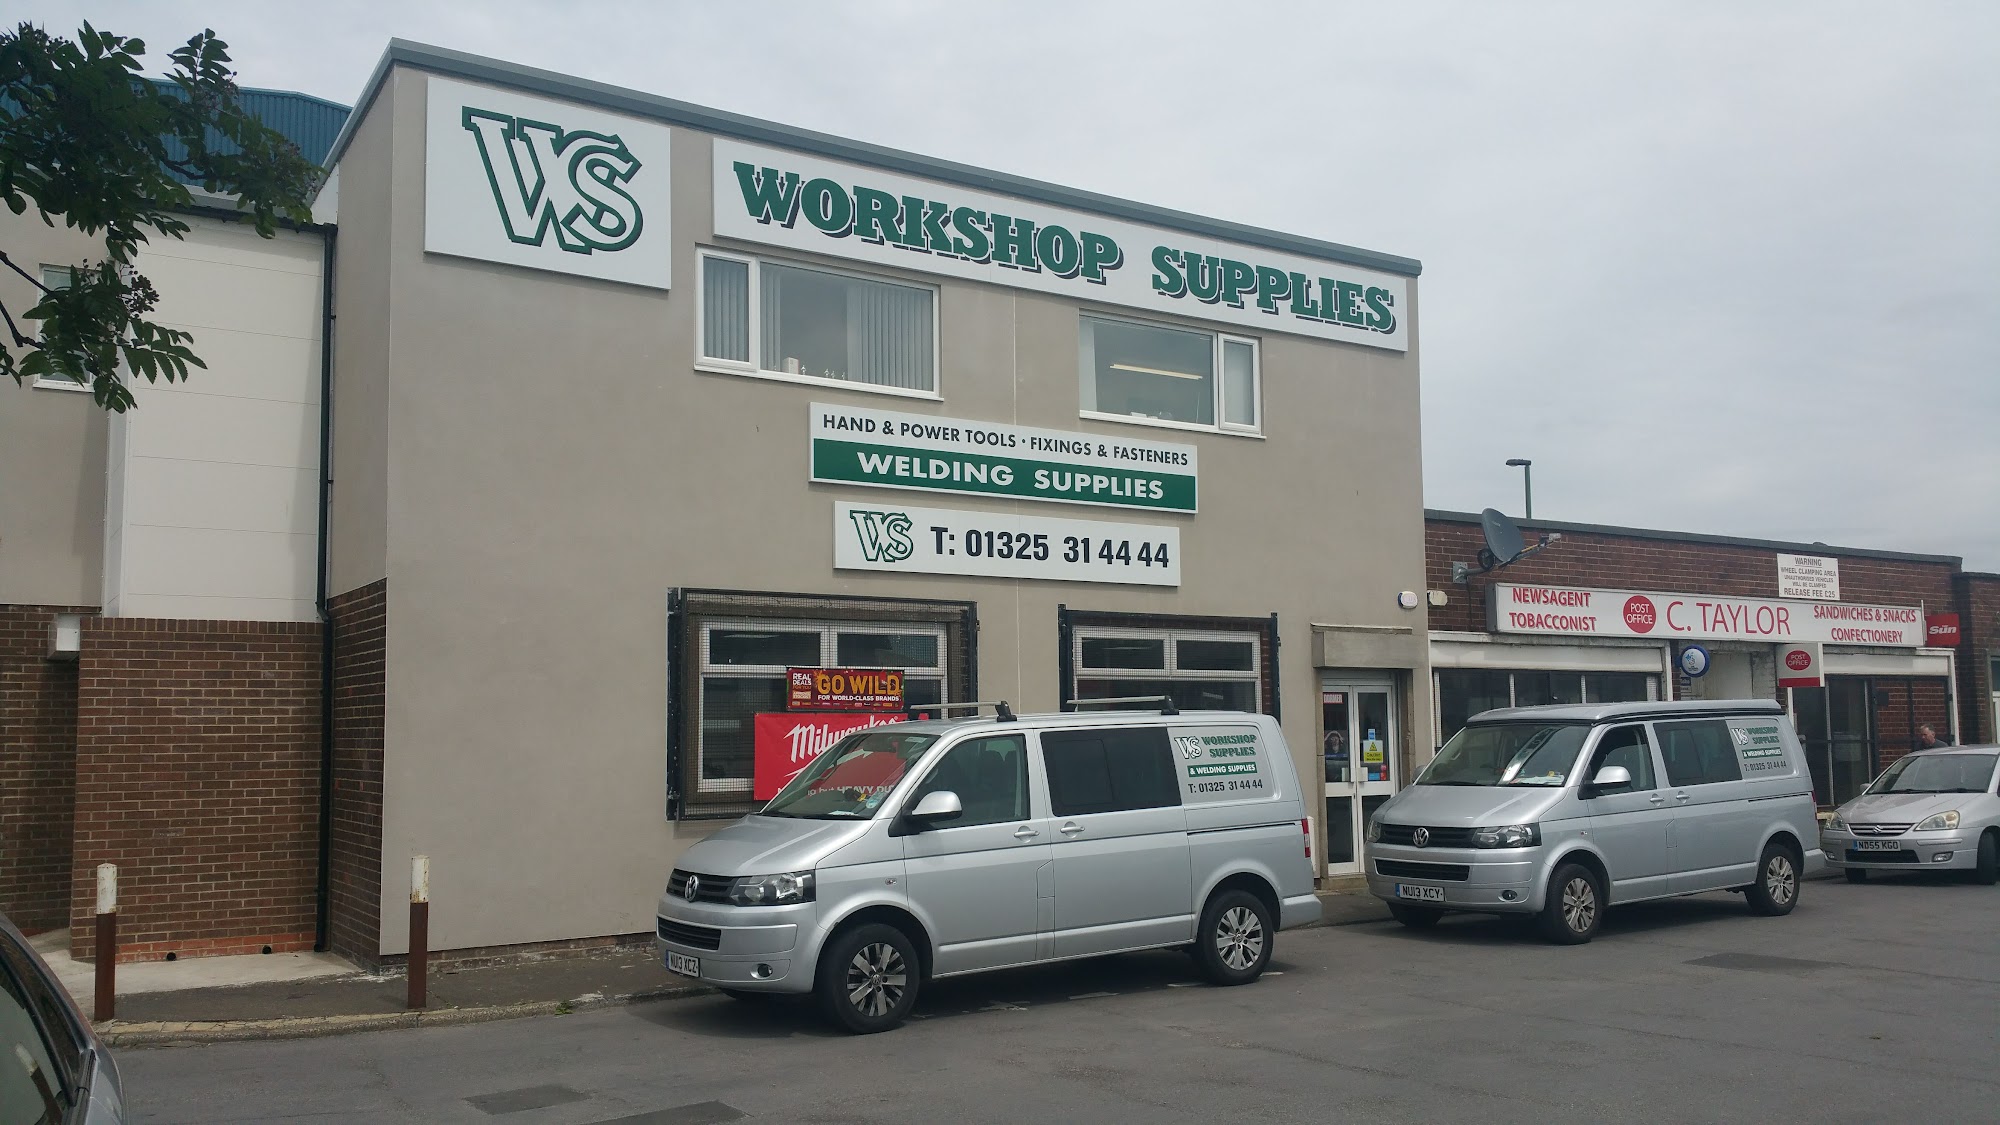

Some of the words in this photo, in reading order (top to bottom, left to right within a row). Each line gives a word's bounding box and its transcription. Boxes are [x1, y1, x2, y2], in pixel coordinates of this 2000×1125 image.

[462, 106, 643, 255] WS
[733, 161, 1123, 285] WORKSHOP
[1151, 245, 1396, 334] SUPPLIES
[823, 414, 876, 433] HAND
[882, 420, 895, 436] &
[901, 422, 960, 442] POWER
[965, 429, 1016, 448] TOOLS
[1030, 437, 1091, 456] FIXINGS
[1097, 444, 1108, 458] &
[1113, 445, 1188, 466] FASTENERS
[857, 452, 1014, 486] WELDING
[1034, 469, 1164, 500] SUPPLIES
[850, 510, 914, 563] WS
[930, 526, 955, 555] T:
[965, 529, 1049, 561] 01325
[1795, 557, 1822, 566] WARNING
[1799, 568, 1822, 576] CLAMPING
[1512, 587, 1591, 607] NEWSAGENT
[1784, 588, 1810, 596] RELEASE
[1825, 590, 1835, 598] £25
[1630, 603, 1649, 614] POST
[1814, 605, 1873, 621] SANDWICHES
[1875, 609, 1882, 622] &
[1883, 609, 1916, 624] SNACKS
[1509, 612, 1596, 632] TOBACCONIST
[1626, 613, 1653, 624] OFFICE
[1667, 601, 1691, 631] C.
[1696, 603, 1791, 635] TAYLOR
[1831, 627, 1903, 643] CONFECTIONERY
[1929, 625, 1957, 634] Sun
[817, 674, 845, 695] GO
[849, 674, 900, 695] WILD
[1201, 734, 1257, 746] WORKSHOP
[1209, 747, 1257, 758] SUPPLIES
[1190, 767, 1195, 775] &
[1197, 765, 1226, 775] WELDING
[1228, 764, 1256, 773] SUPPLIES
[1750, 763, 1765, 771] 01325
[1188, 783, 1196, 793] T:
[1198, 781, 1225, 793] 01325
[1858, 841, 1880, 849] ND55
[1402, 885, 1421, 897] NU13
[1423, 887, 1440, 899] XCY
[684, 957, 697, 973] XCZ
